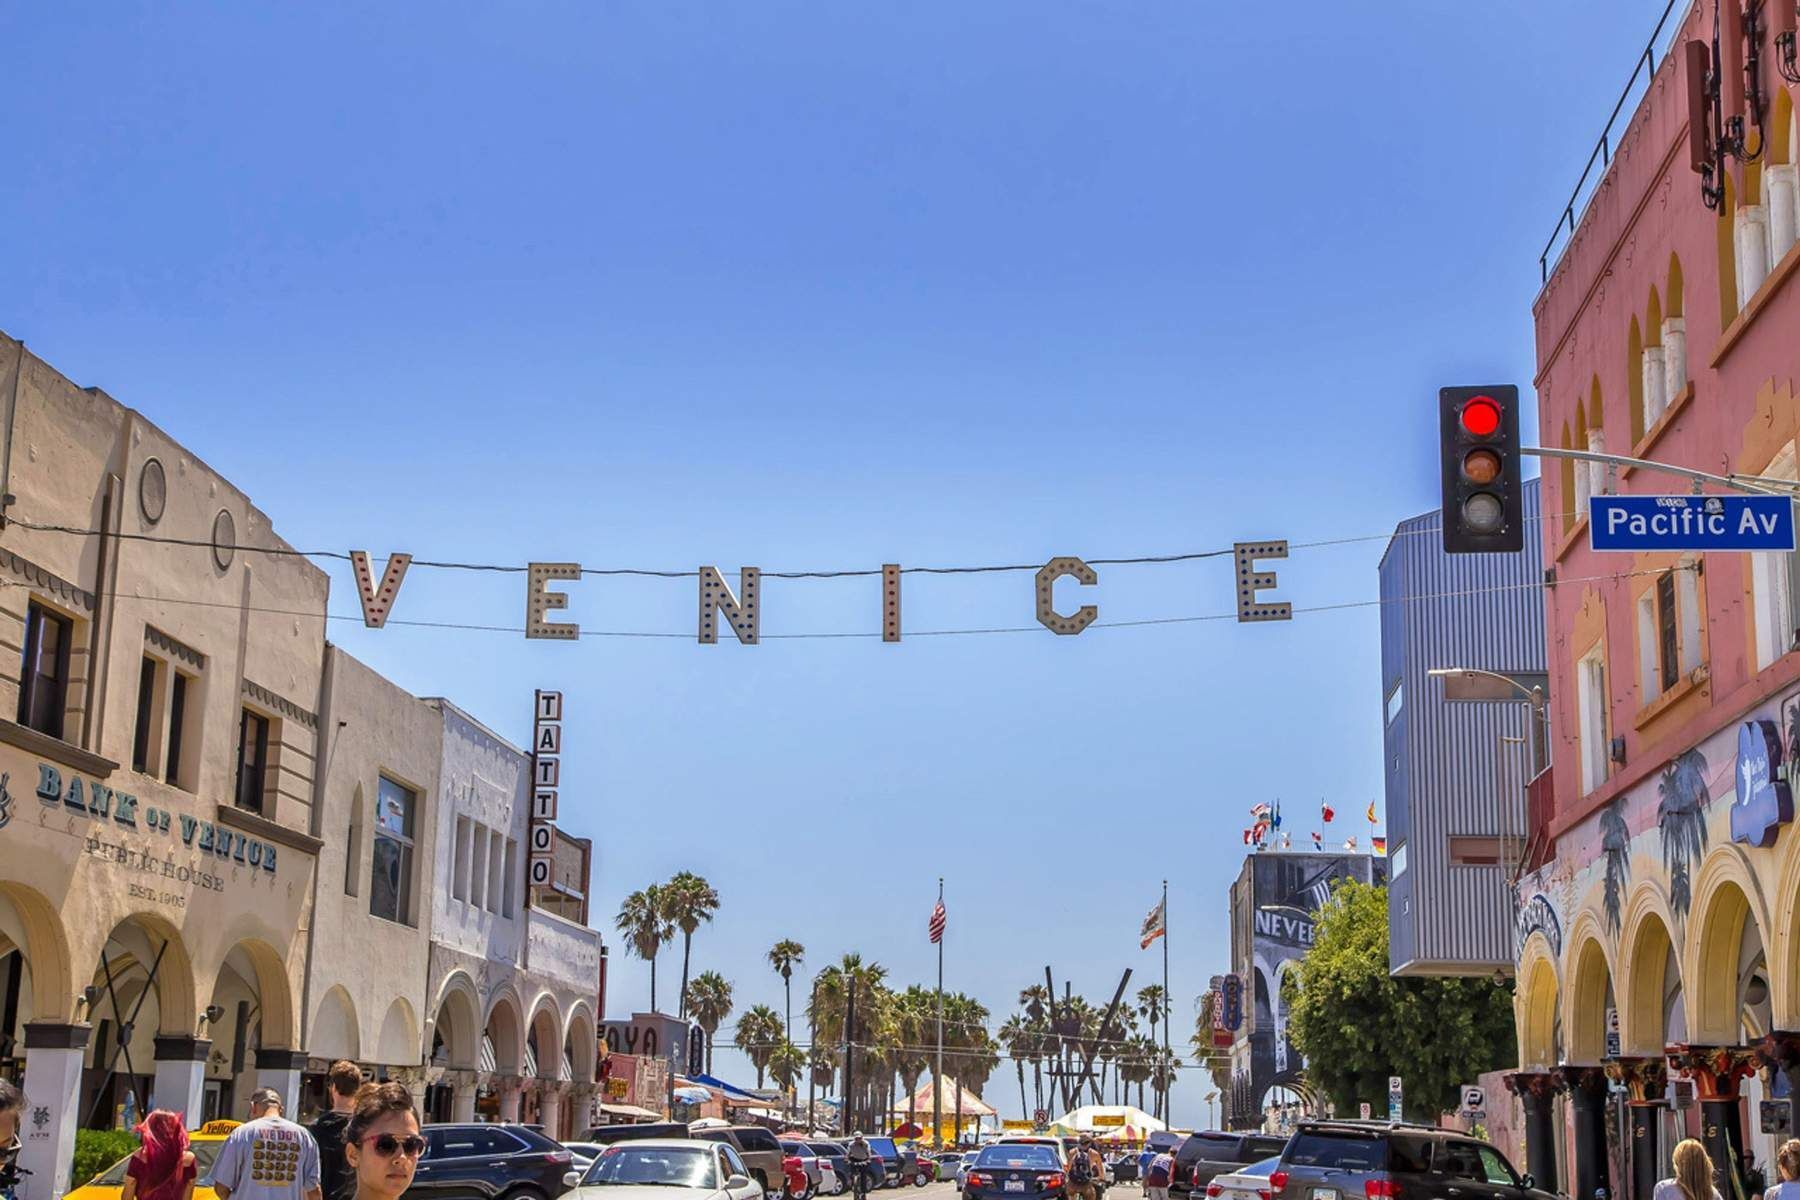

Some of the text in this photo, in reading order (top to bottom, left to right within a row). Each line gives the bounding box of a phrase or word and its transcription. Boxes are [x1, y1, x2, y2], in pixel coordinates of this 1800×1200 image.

[1608, 507, 1778, 535] Pacific Av
[349, 540, 1292, 644] VENICE
[36, 762, 277, 872] BANK OF VENICE
[533, 695, 556, 883] TATTOO
[160, 860, 225, 893] HOUSE
